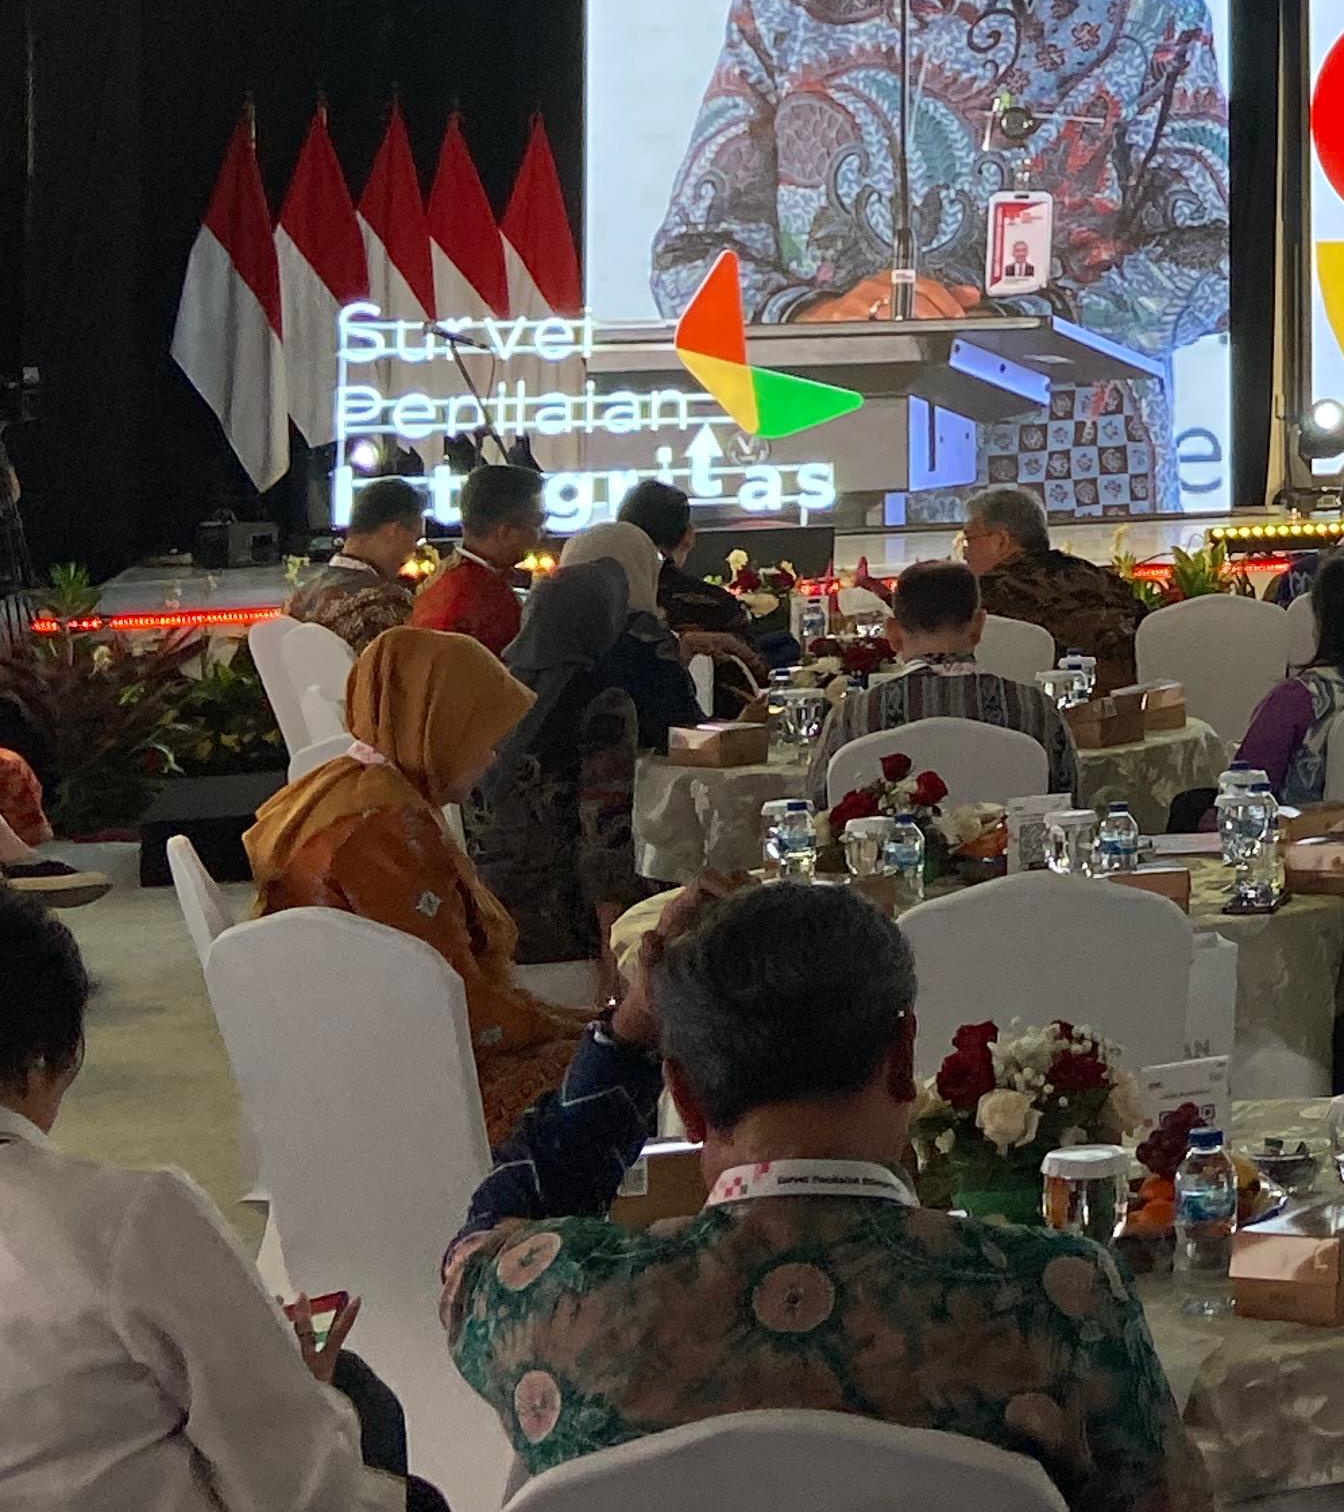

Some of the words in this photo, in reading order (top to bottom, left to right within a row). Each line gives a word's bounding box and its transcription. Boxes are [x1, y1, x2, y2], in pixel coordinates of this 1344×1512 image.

[337, 301, 593, 363] Survei
[337, 377, 690, 440] Penilaian
[332, 425, 836, 532] Itgritas
